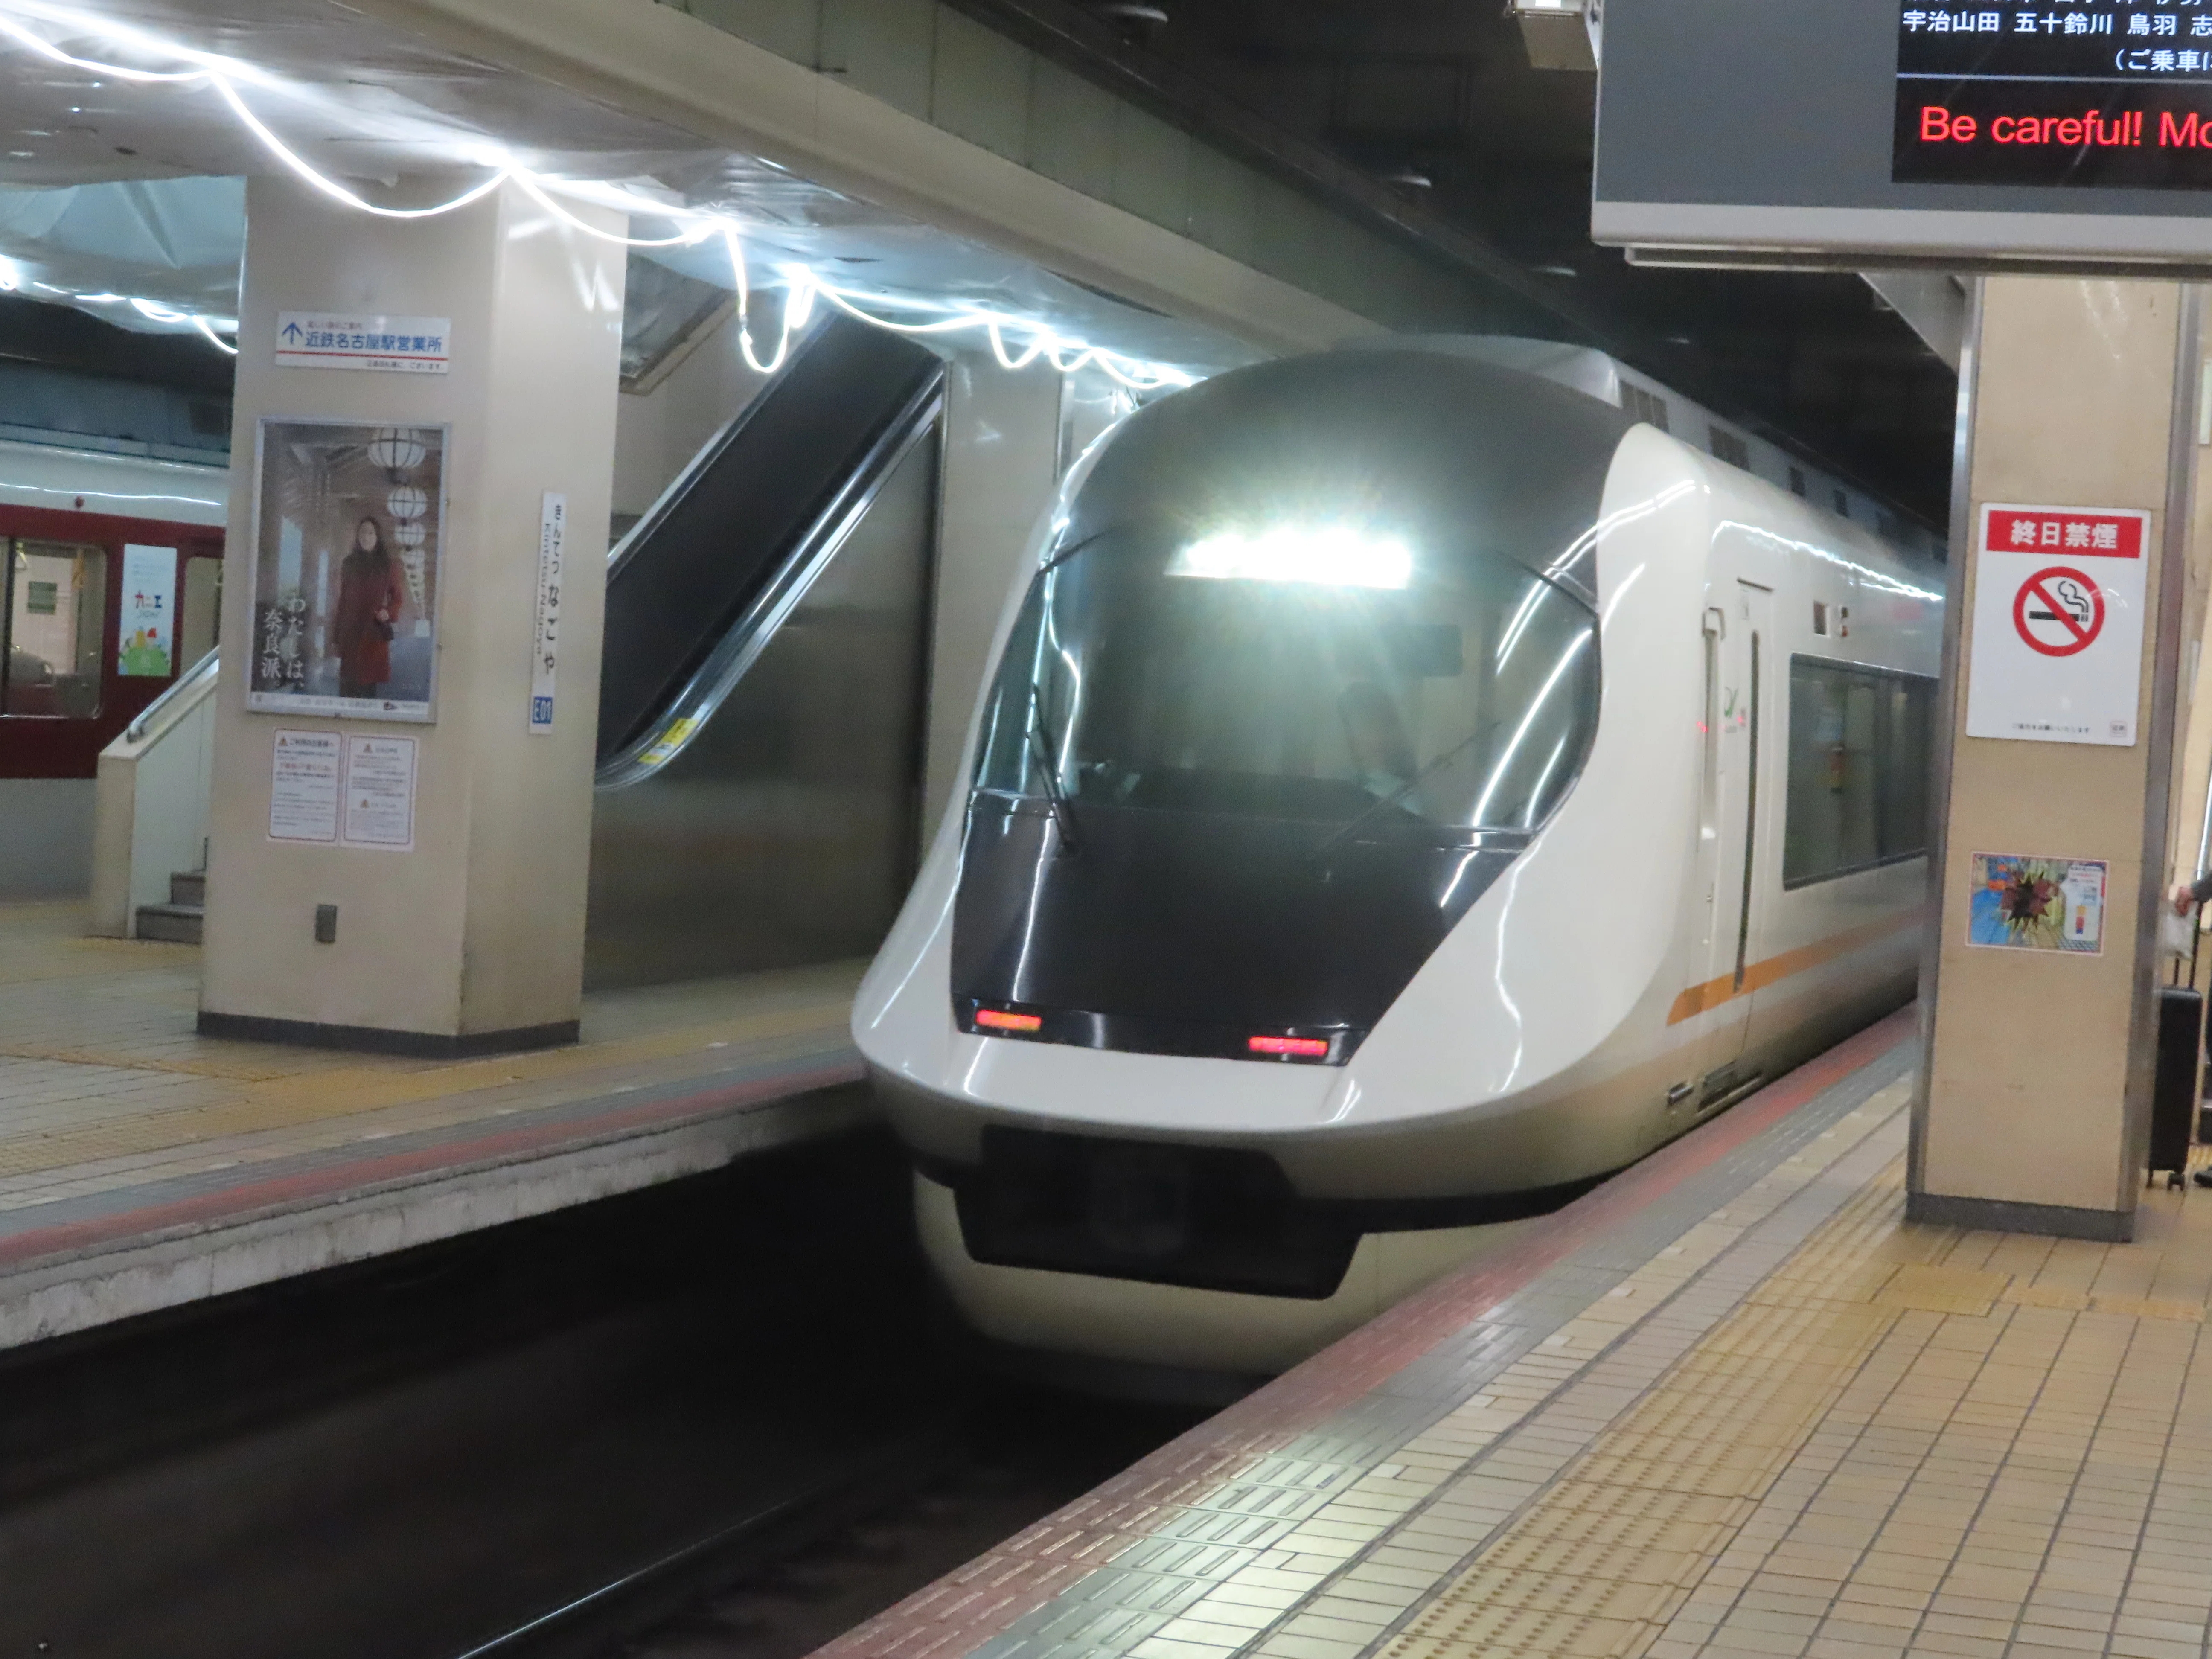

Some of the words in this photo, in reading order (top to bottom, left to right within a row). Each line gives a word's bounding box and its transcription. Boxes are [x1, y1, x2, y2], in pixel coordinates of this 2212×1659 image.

[1903, 10, 2000, 33] 宇治山田
[2014, 12, 2113, 35] 五十鈴川
[2127, 13, 2177, 36] 鳥羽
[1921, 106, 1977, 143] Be
[1991, 110, 2143, 147] careful!
[305, 332, 442, 352] 近鉄名古屋駅営業所
[2009, 518, 2119, 550] 終日禁煙
